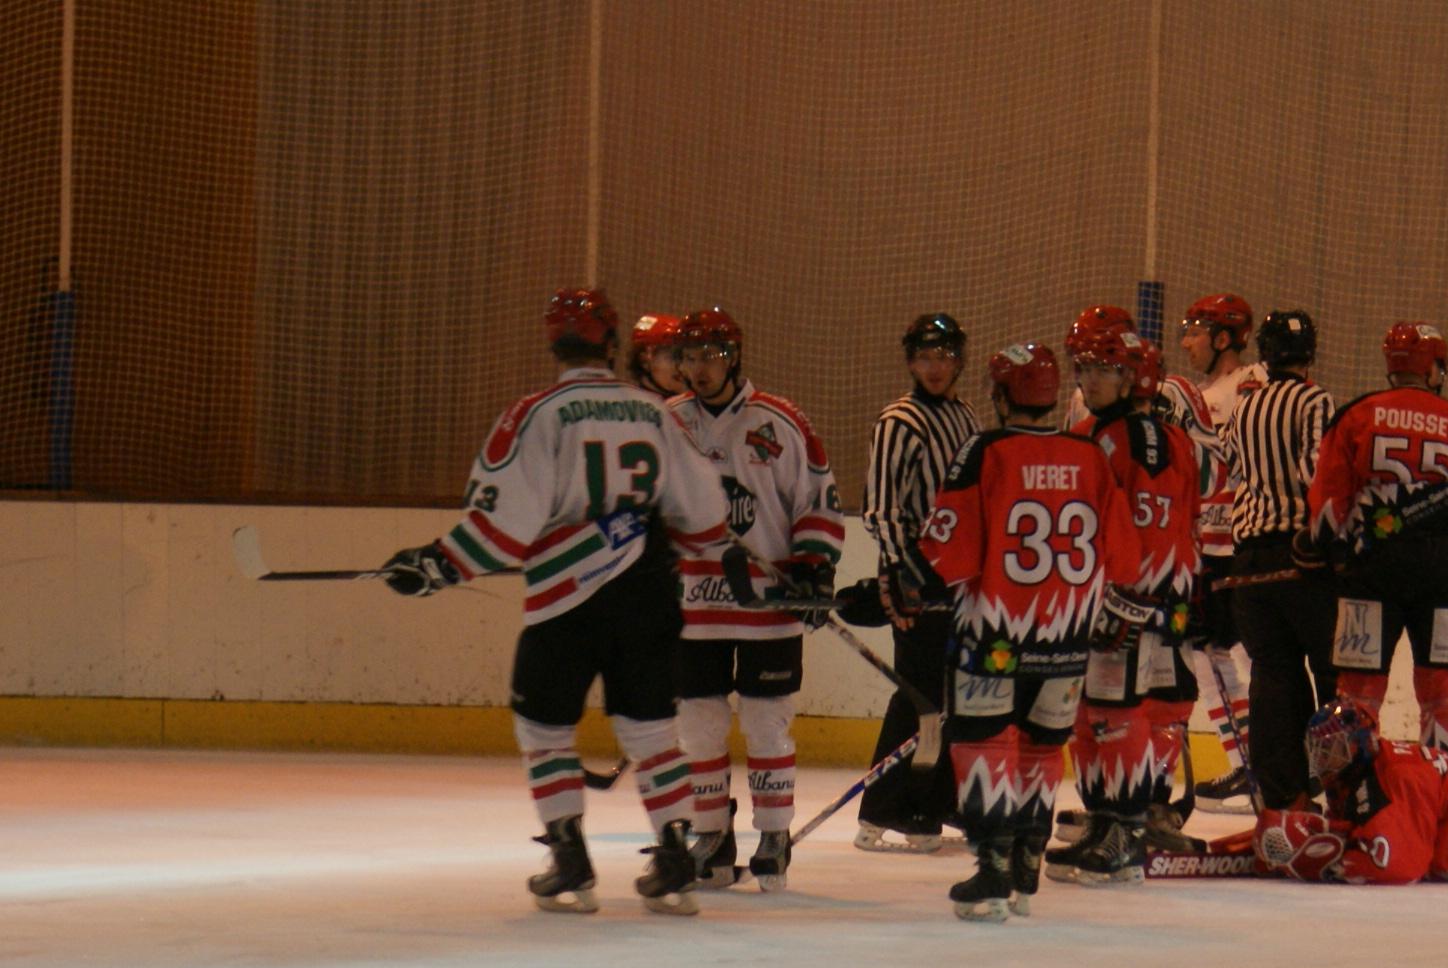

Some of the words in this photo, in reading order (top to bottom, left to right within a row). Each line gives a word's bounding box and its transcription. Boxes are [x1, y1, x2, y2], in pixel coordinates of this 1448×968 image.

[584, 441, 661, 521] 13
[1021, 464, 1081, 491] VERET
[463, 480, 499, 513] 13
[1133, 492, 1172, 529] 57
[1003, 500, 1099, 586] 33
